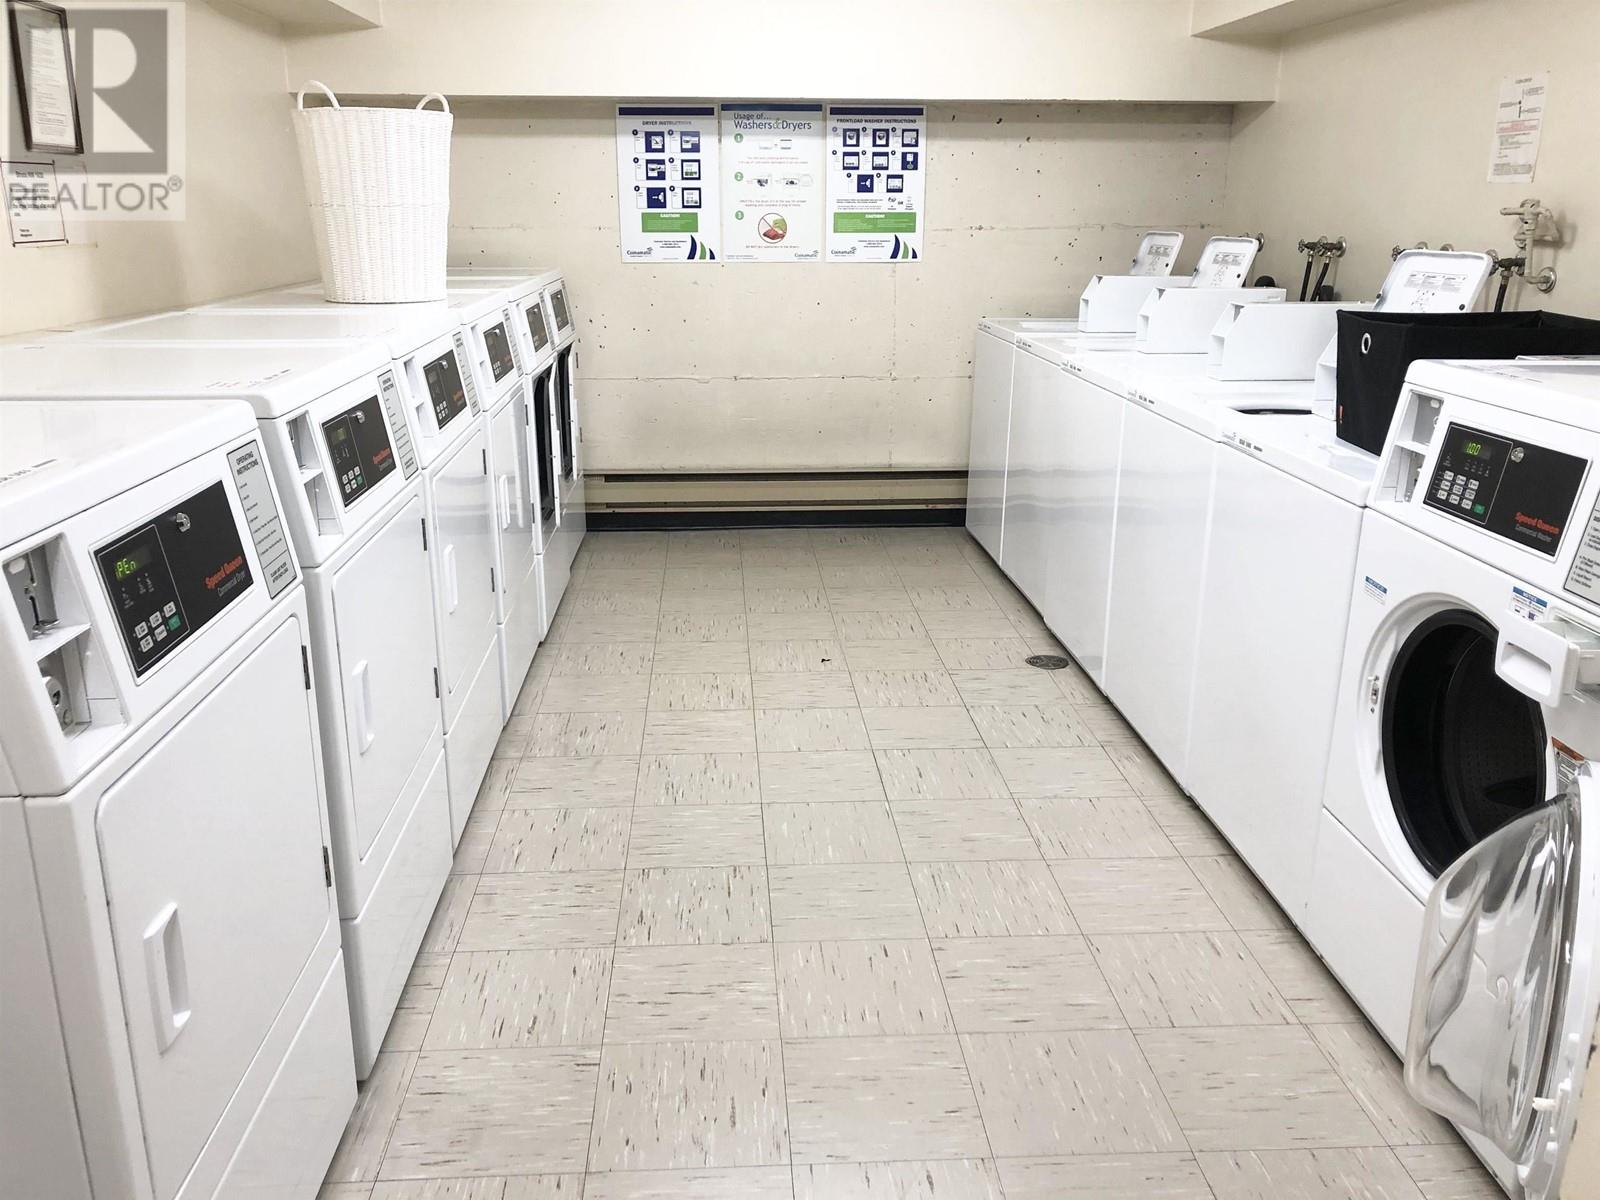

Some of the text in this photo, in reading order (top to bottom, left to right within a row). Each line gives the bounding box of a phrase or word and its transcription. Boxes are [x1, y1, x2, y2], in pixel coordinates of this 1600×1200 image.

[733, 112, 754, 120] Usage
[733, 120, 772, 129] Washers
[782, 120, 812, 132] Dryers
[1515, 511, 1560, 534] Speed Queen
[205, 555, 243, 590] Speed Queen
